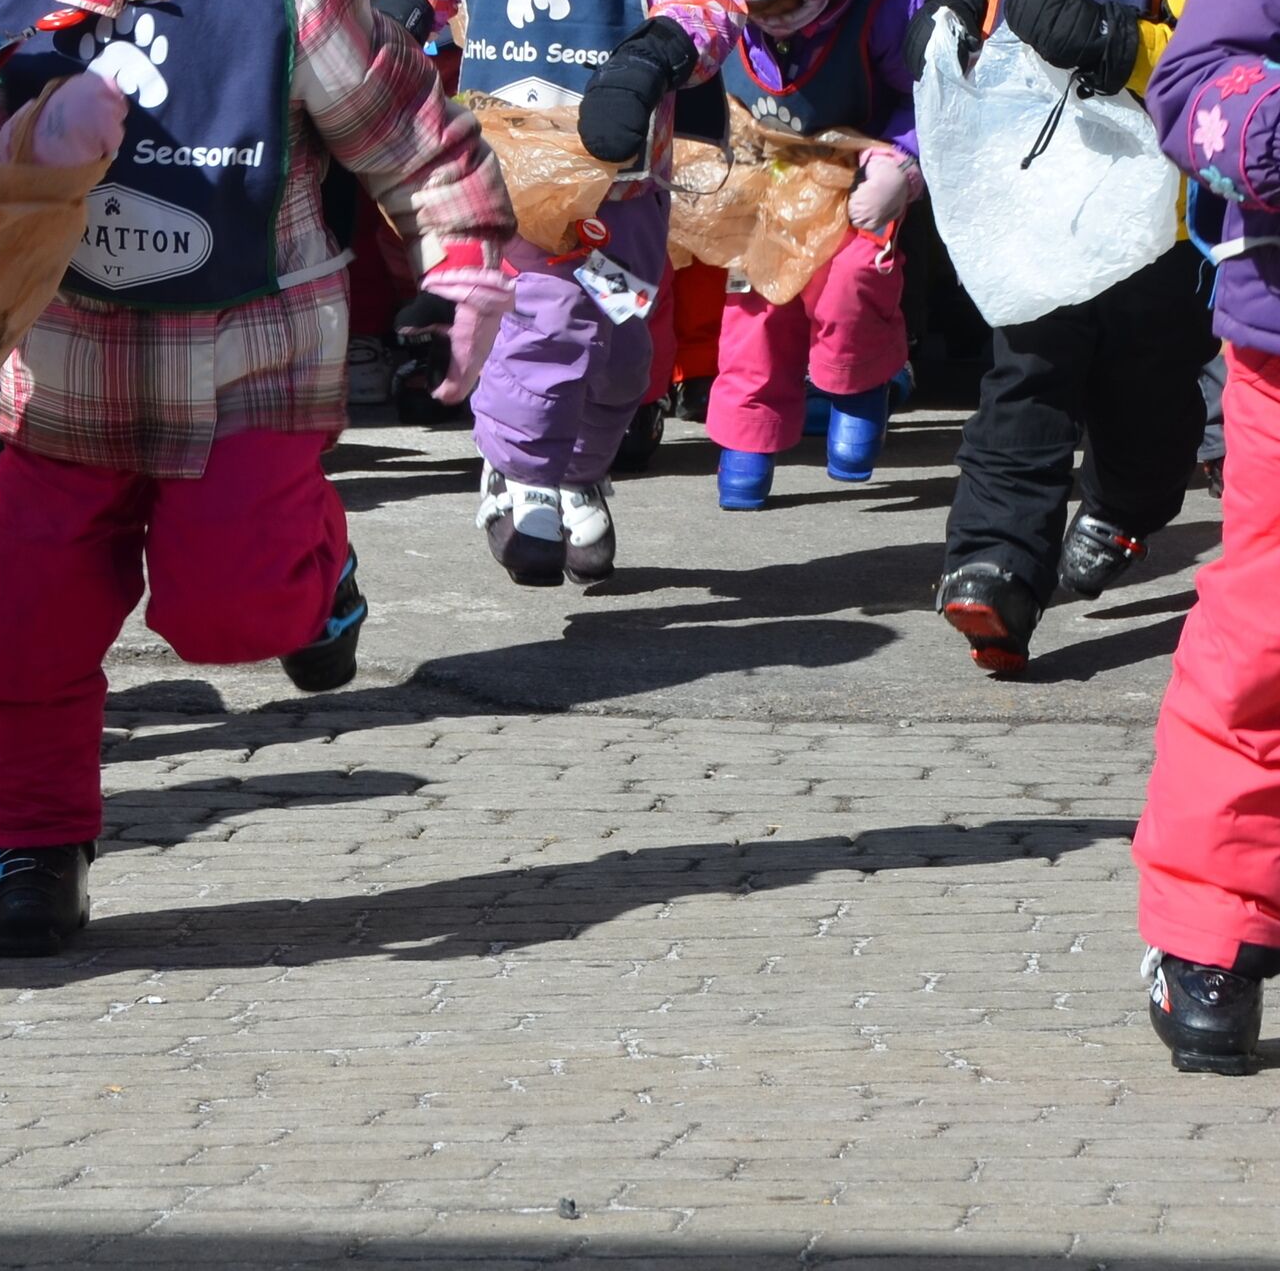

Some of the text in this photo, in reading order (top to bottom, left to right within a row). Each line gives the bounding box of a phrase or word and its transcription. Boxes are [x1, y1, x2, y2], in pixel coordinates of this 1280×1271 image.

[502, 40, 538, 63] Cub
[545, 42, 613, 66] Seaso
[133, 138, 265, 168] Seasonal
[102, 264, 125, 277] VT
